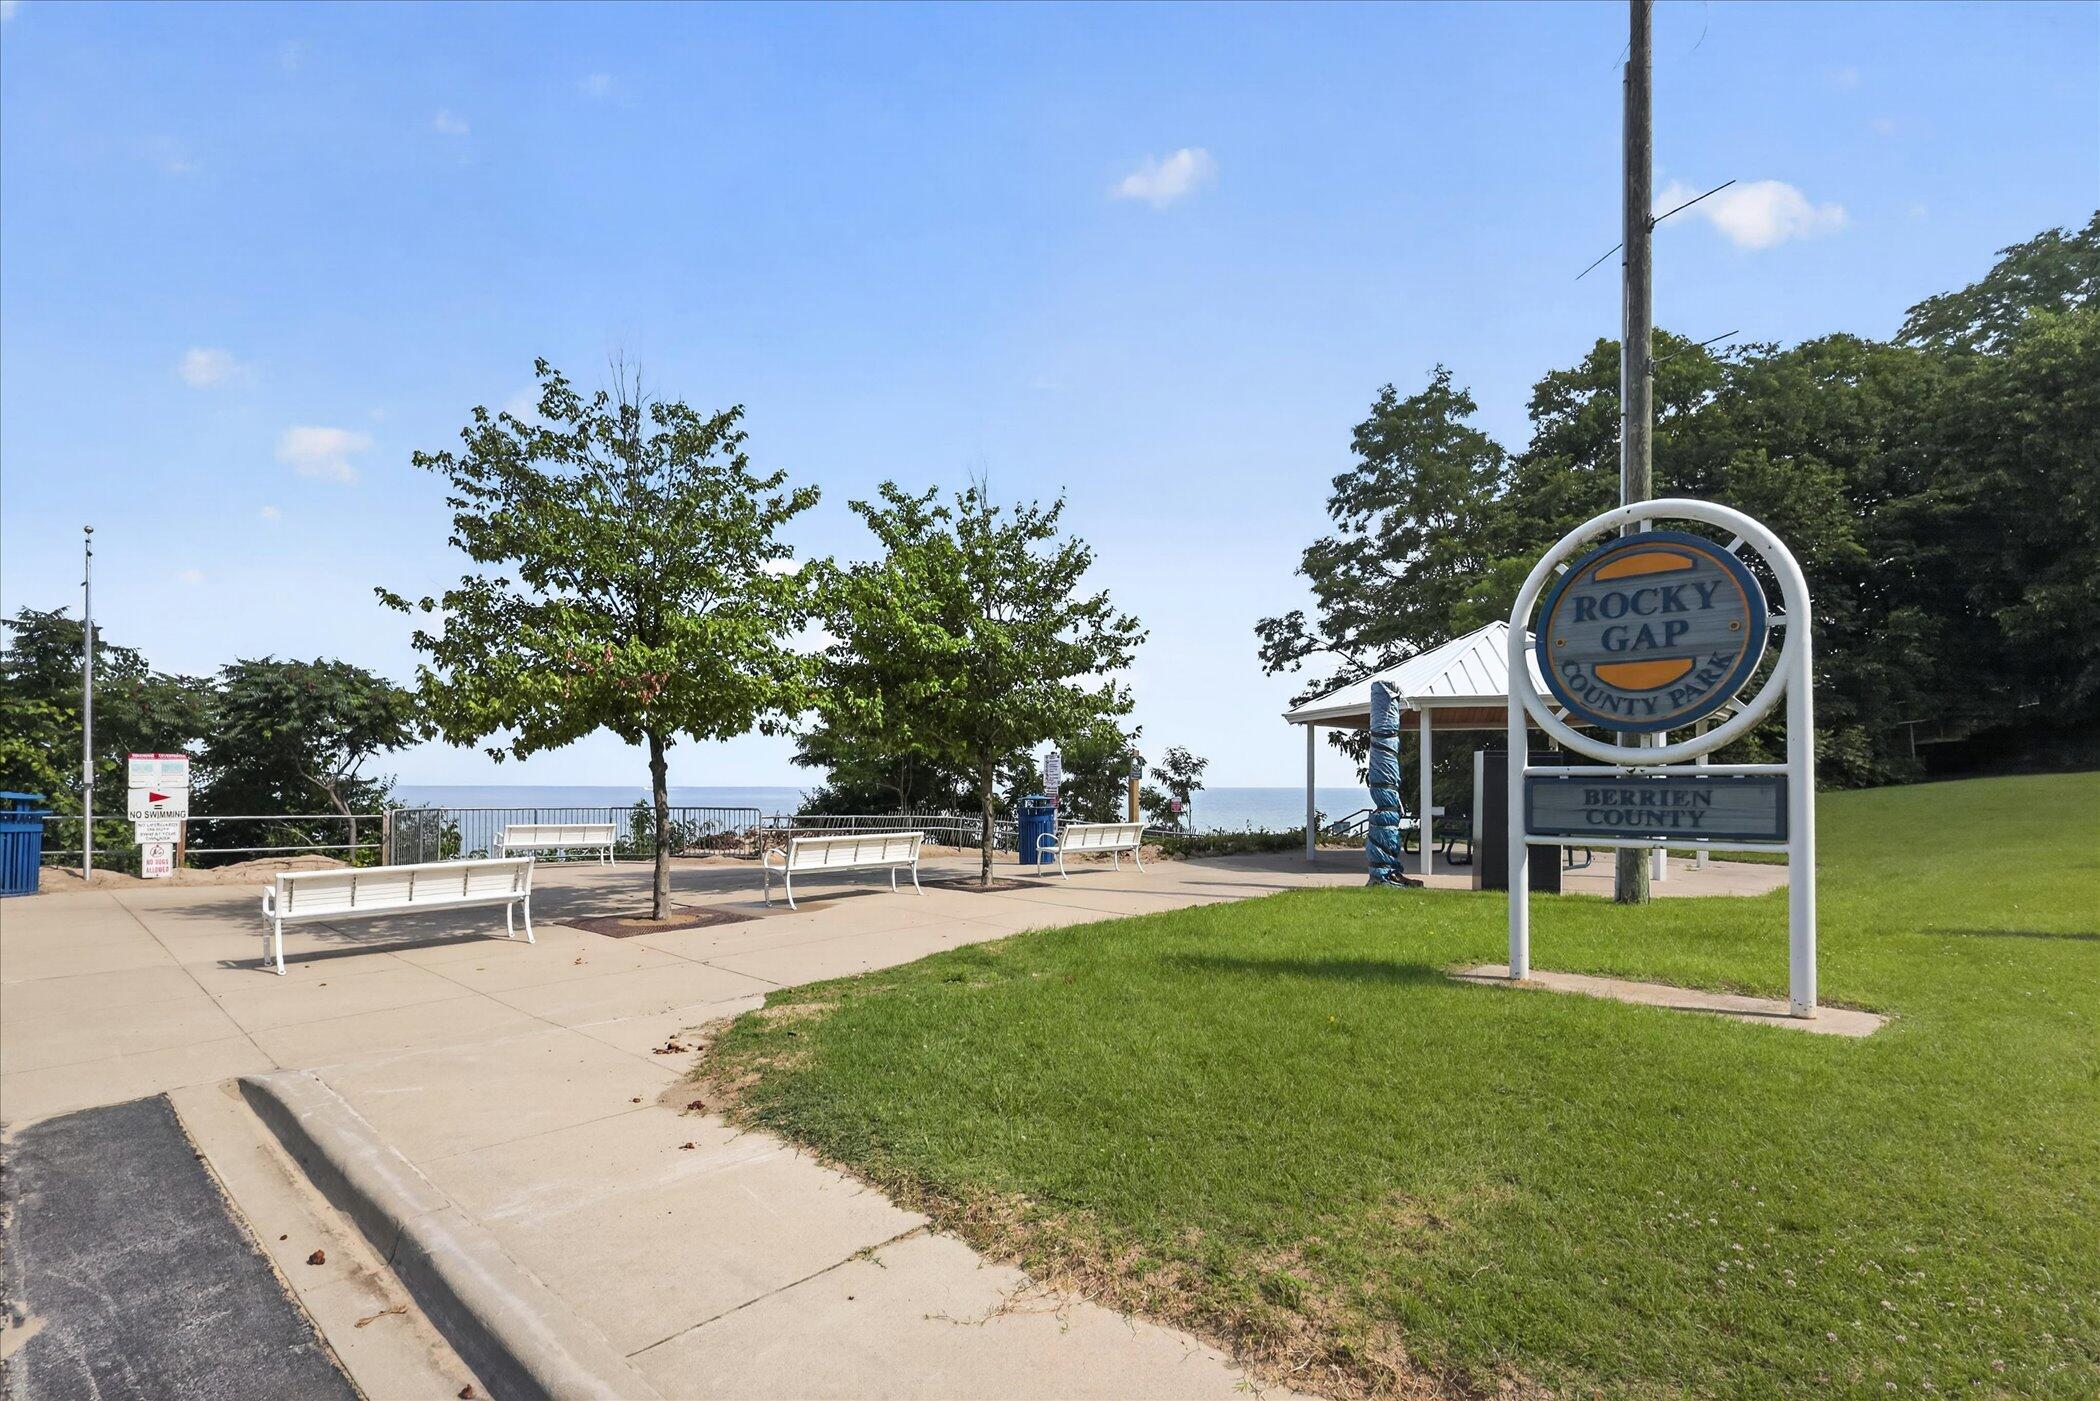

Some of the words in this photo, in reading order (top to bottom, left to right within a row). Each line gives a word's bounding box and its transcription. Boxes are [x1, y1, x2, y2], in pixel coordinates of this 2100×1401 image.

[1573, 580, 1722, 623] ROCKY
[1601, 619, 1689, 652] GAP
[1561, 659, 1658, 715] COUNTY
[1668, 651, 1736, 708] PARK
[1584, 789, 1713, 807] BERRIEN
[130, 811, 142, 819] NO
[144, 811, 186, 819] SWIMMING
[1586, 808, 1705, 827] COUNTY
